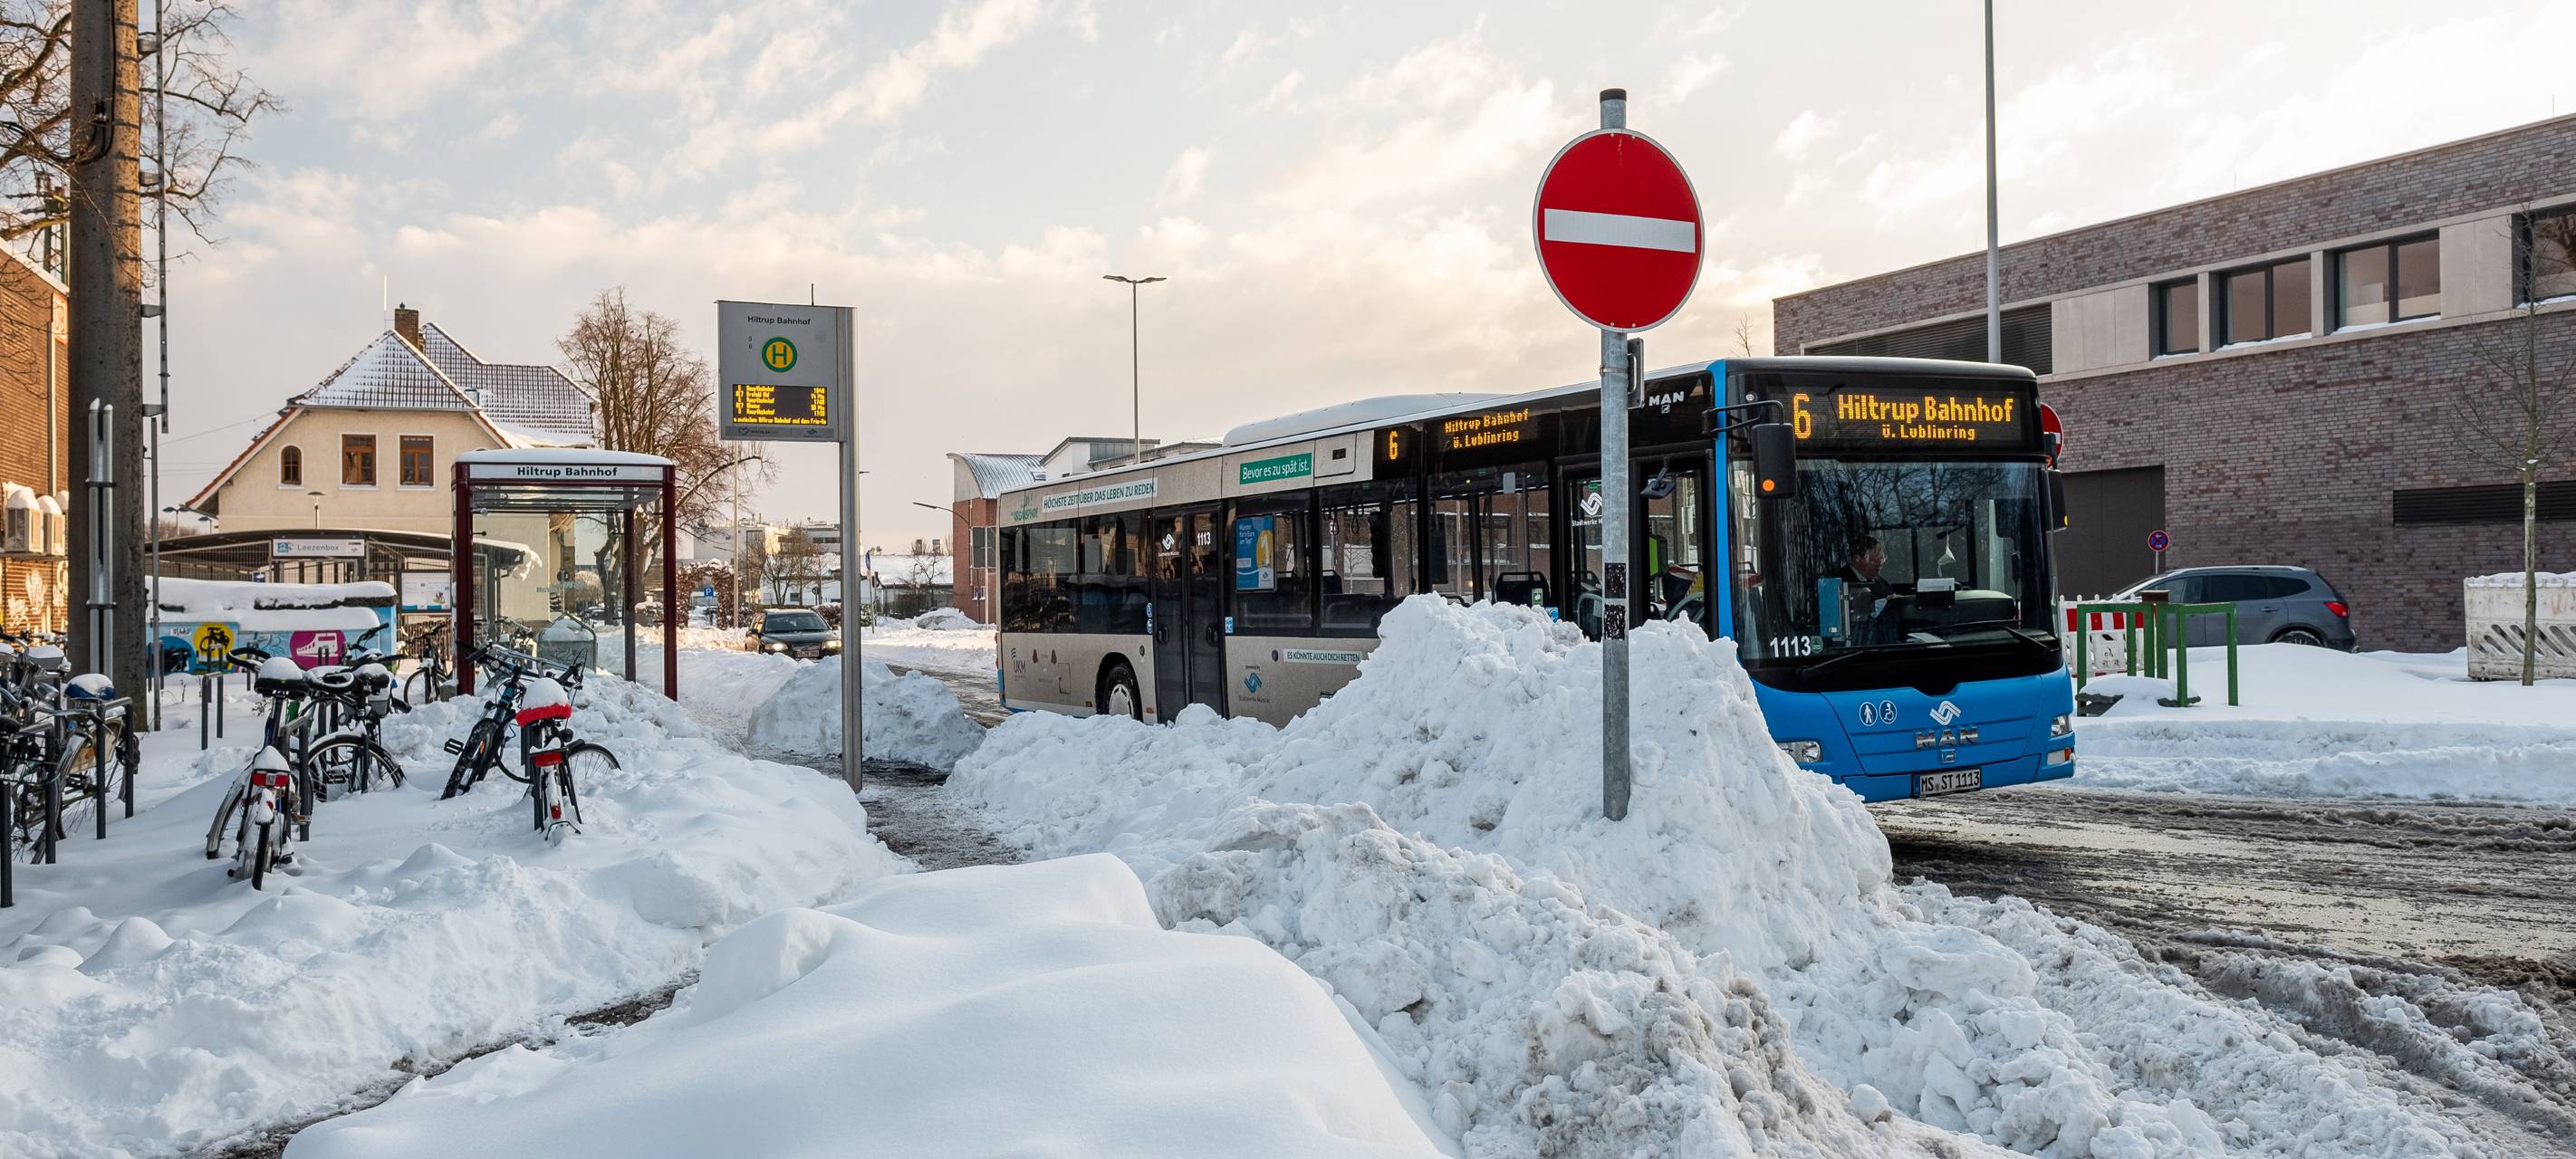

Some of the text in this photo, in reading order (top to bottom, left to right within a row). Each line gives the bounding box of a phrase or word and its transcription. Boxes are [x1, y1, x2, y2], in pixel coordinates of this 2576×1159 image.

[747, 315, 811, 325] Hiltrup Bahnhof
[772, 345, 787, 365] H
[1648, 391, 1685, 407] MAN
[1793, 393, 2014, 439] 6 Hiltrup Bahnhof
[1389, 407, 1529, 460] 6 Hiltrup Bahnhof
[1453, 429, 1519, 449] ü. Lublinring
[1881, 424, 1976, 440] ü. Lublinring
[517, 467, 618, 478] Hiltrup Bahnhof
[1243, 458, 1310, 480] Bevor es zu spät ist.
[1043, 497, 1067, 509] HÖCHSTE
[1068, 494, 1079, 505] ZEIT
[1080, 492, 1094, 503] ÜBER
[1095, 489, 1106, 502] DAS
[1107, 487, 1125, 500] LEBEN
[1125, 485, 1134, 497] ZU
[1197, 532, 1211, 546] 1113
[1293, 651, 1312, 660] KÖNNTE
[1313, 652, 1328, 661] AUCH
[1328, 653, 1341, 661] DICH
[1770, 636, 1812, 657] 1113
[1014, 660, 1026, 674] UKM
[1916, 726, 1978, 749] MAN
[1921, 777, 1934, 792] MS
[1941, 774, 1954, 790] ST
[1956, 771, 1980, 788] 1113
